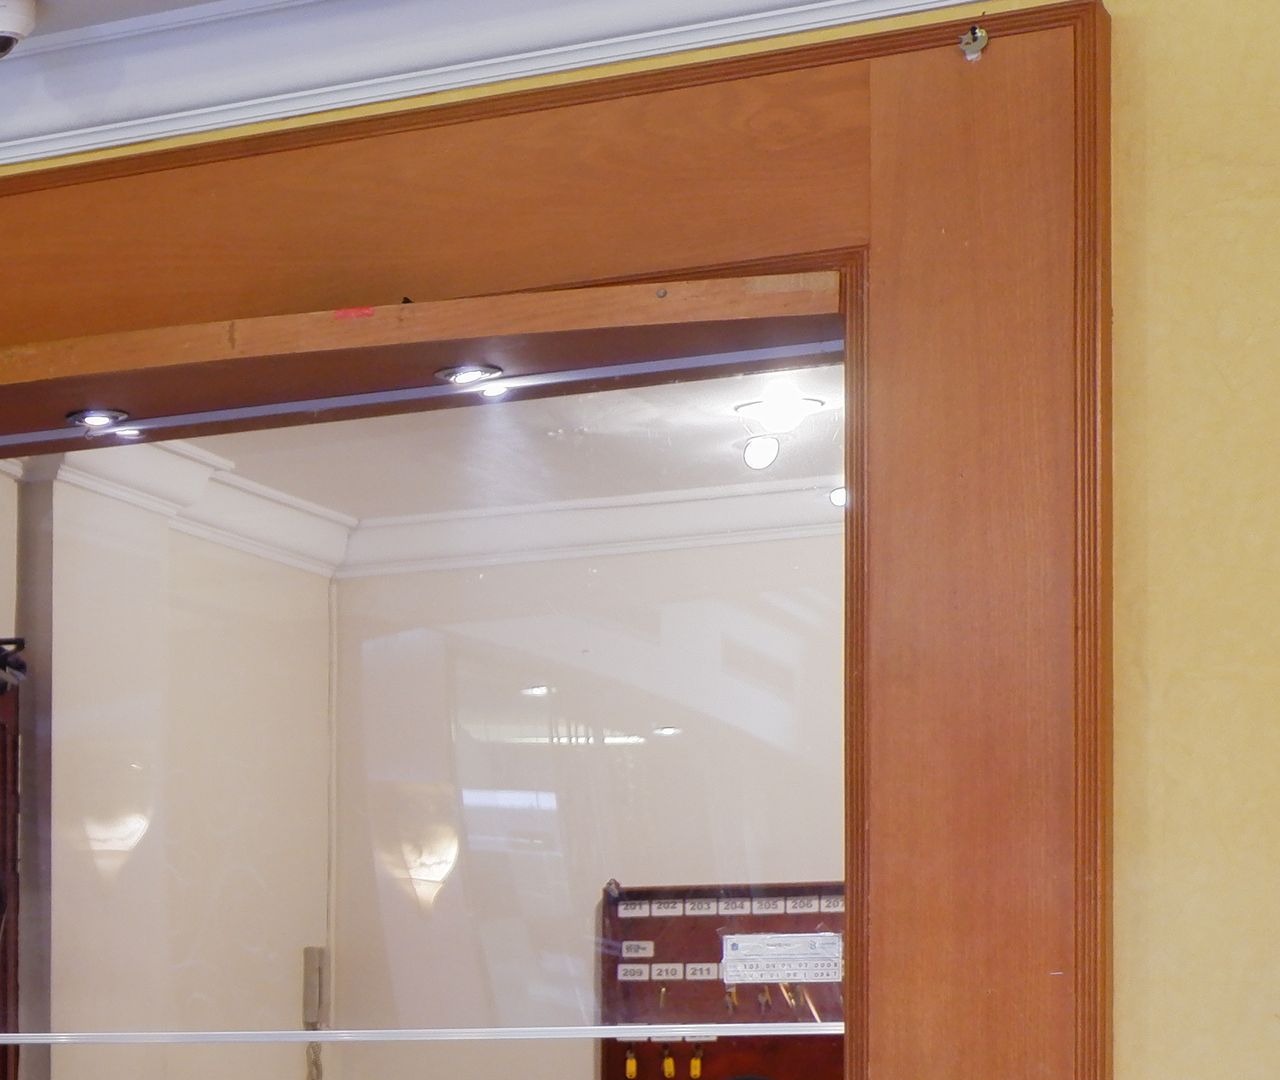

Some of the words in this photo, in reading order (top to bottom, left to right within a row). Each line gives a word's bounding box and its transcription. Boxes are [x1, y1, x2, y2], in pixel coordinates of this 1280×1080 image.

[623, 902, 643, 911] 201
[656, 901, 677, 910] 202
[690, 901, 711, 911] 203
[723, 901, 744, 910] 204
[757, 900, 778, 910] 205
[791, 899, 813, 909] 206
[622, 968, 644, 977] 209
[656, 968, 678, 977] 210
[690, 967, 711, 976] 211
